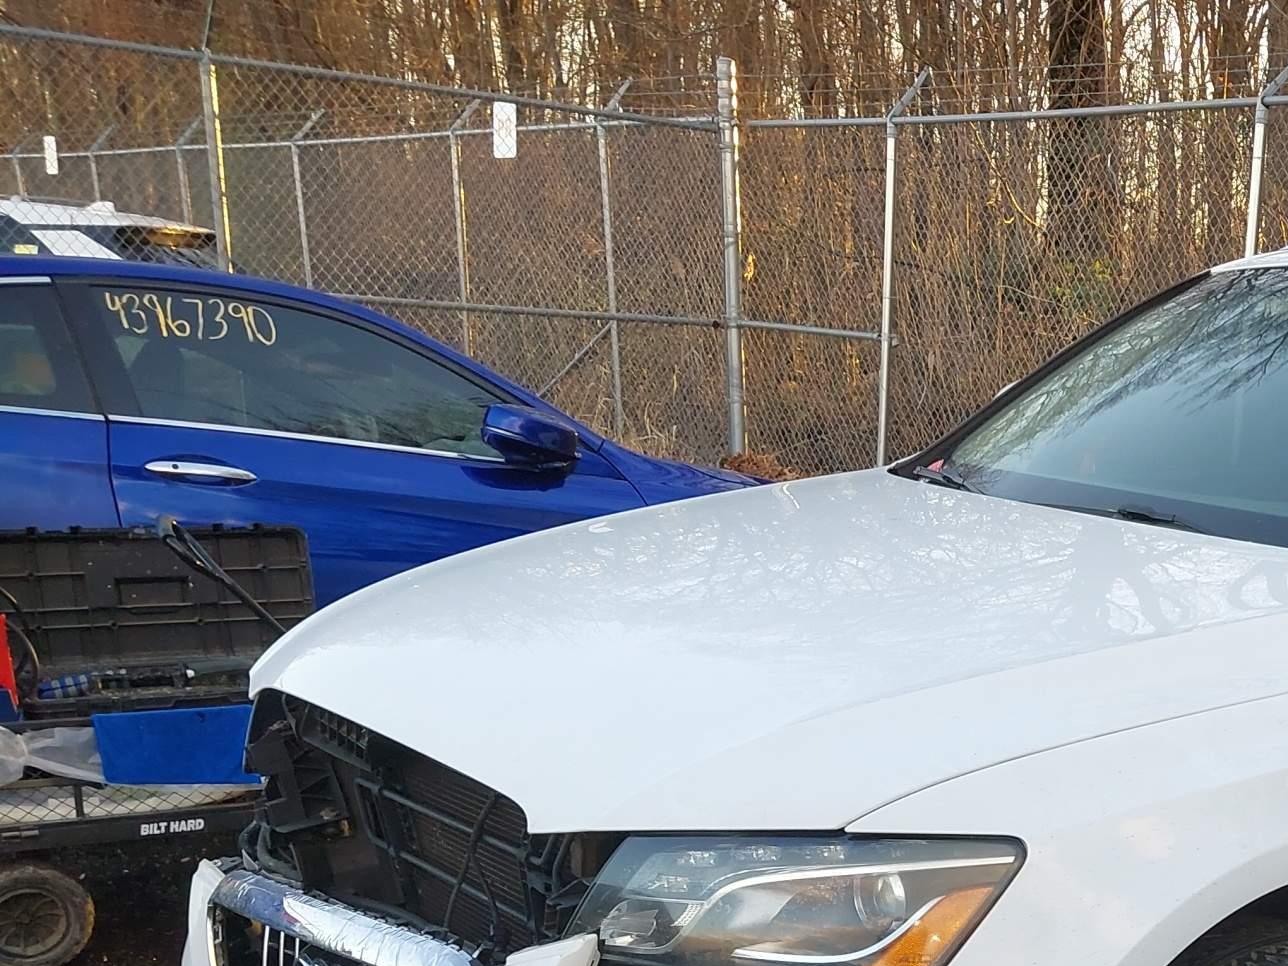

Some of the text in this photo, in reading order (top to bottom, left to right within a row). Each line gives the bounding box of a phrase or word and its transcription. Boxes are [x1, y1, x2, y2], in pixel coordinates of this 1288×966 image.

[104, 292, 277, 346] 43967390
[140, 818, 205, 836] BILT HARD
